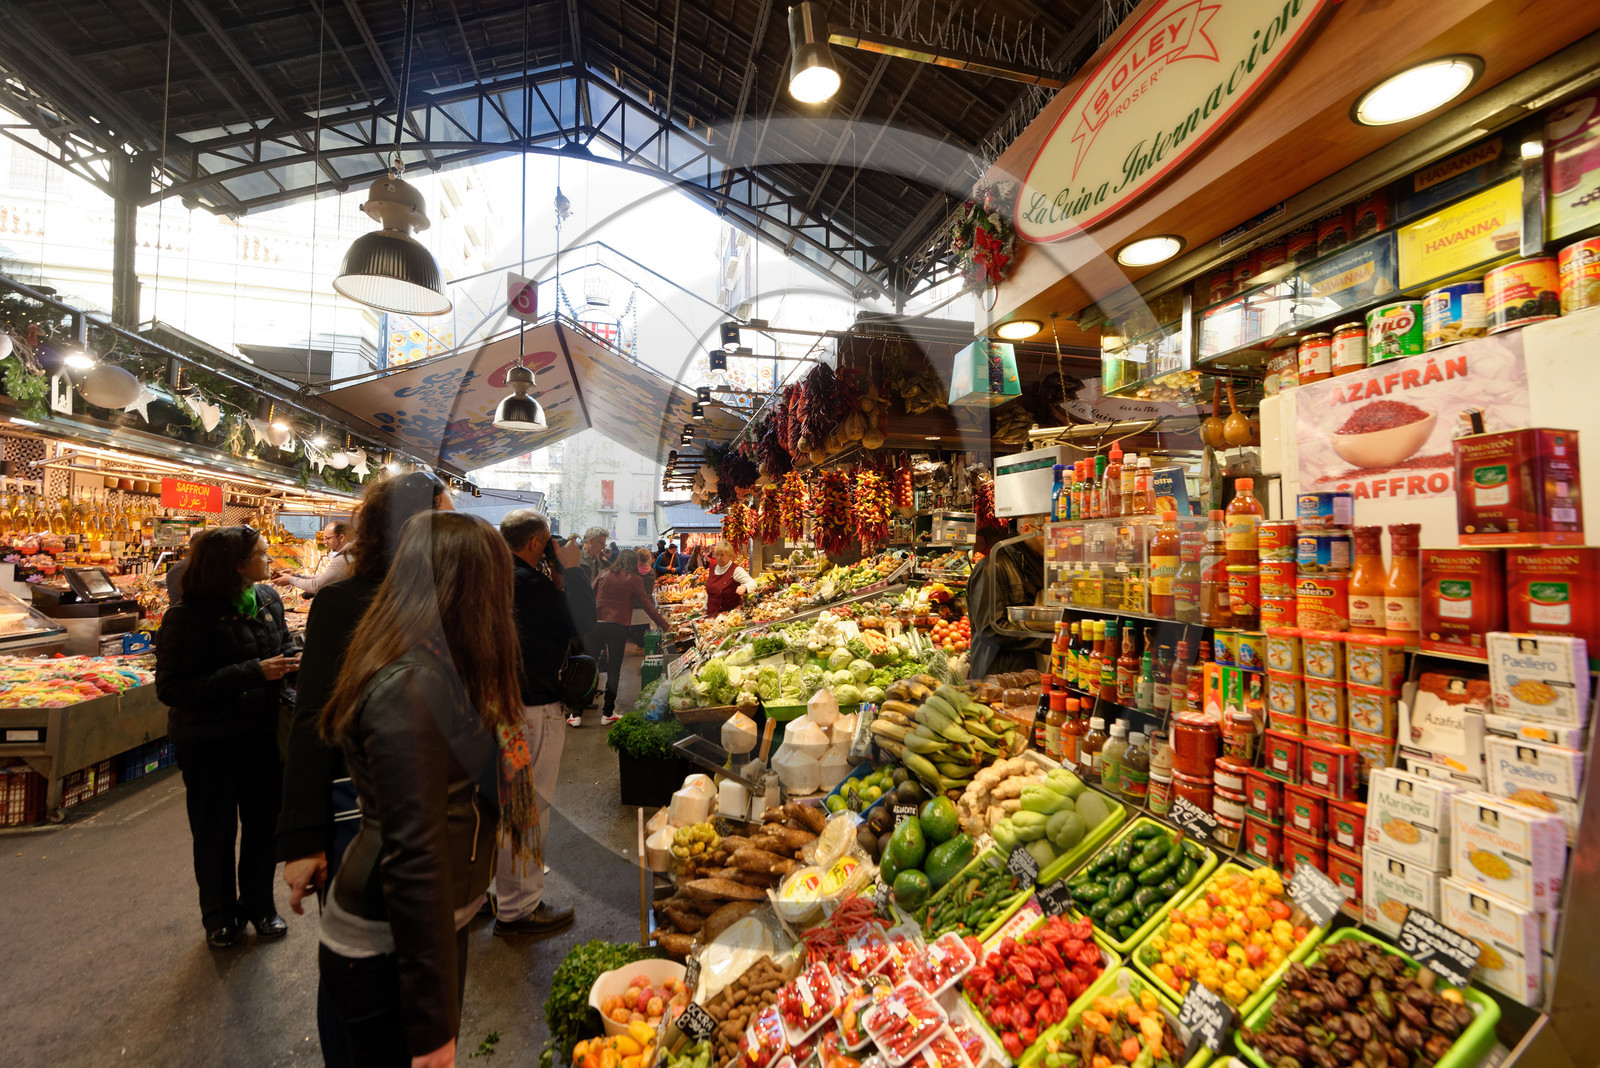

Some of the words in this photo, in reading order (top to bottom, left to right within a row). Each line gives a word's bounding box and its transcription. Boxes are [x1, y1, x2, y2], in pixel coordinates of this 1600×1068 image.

[1094, 17, 1189, 115] SOLEY
[1419, 144, 1497, 187] HAVANNA
[1022, 191, 1048, 225] La
[1049, 180, 1111, 224] Cuina
[1425, 217, 1502, 254] HAVANNA
[1317, 267, 1371, 293] HAVANNA
[517, 288, 530, 309] 6
[1369, 316, 1411, 340] MILO
[1331, 356, 1468, 407] AZAFRÁN
[176, 482, 210, 497] SAFFRON
[179, 494, 207, 510] زعفران
[1336, 472, 1456, 501] SAFFRO
[1501, 653, 1558, 673] Paellero
[1500, 759, 1558, 785] Paellero
[1174, 795, 1218, 827] JALAPEÑO
[1379, 791, 1430, 819] Marinera
[1459, 820, 1523, 853] Valenciana
[1372, 870, 1423, 903] Marinera
[1451, 908, 1515, 945] Valenciana
[686, 1001, 715, 1032] OCKRA
